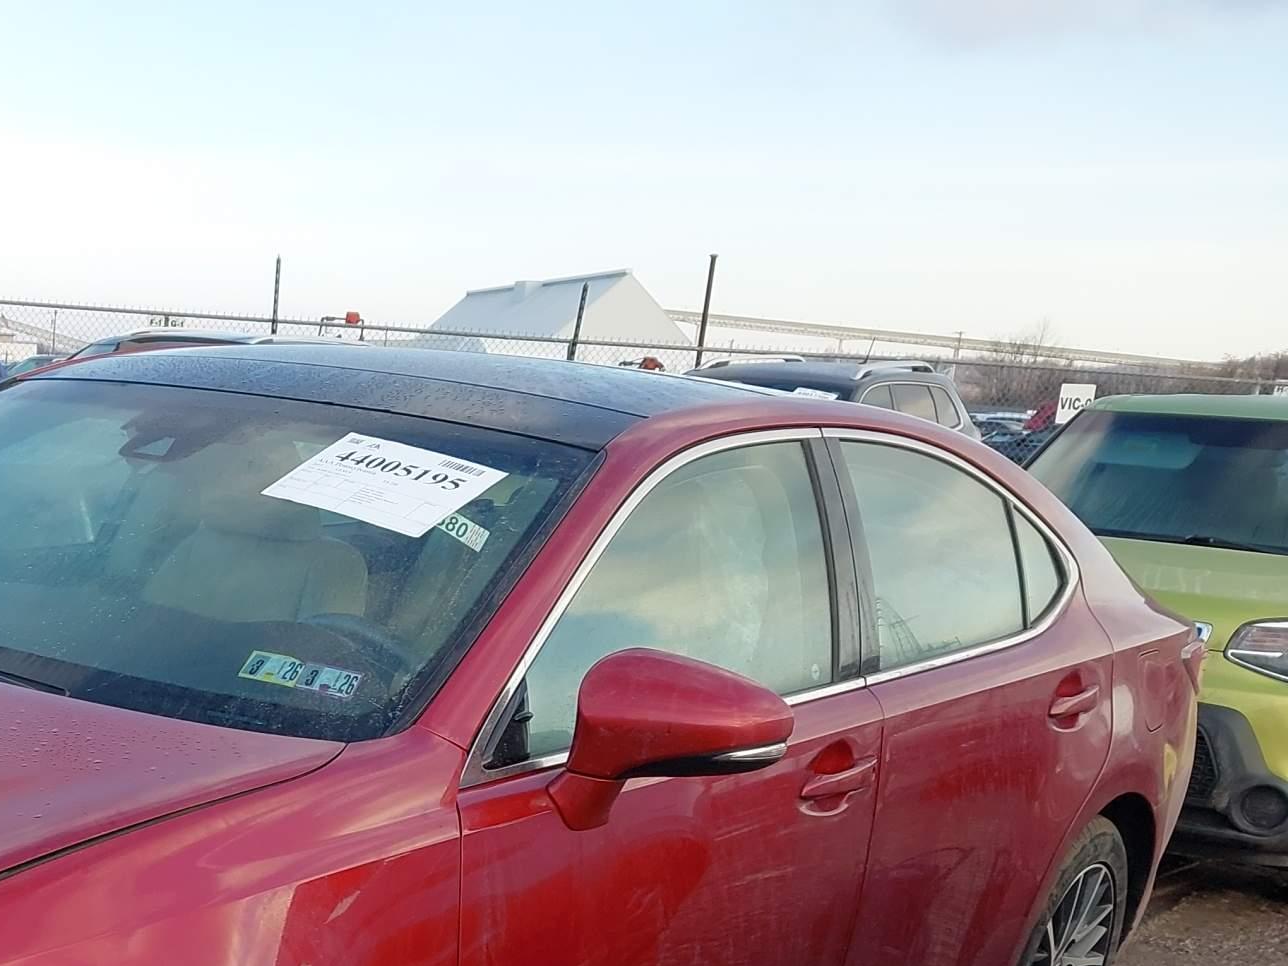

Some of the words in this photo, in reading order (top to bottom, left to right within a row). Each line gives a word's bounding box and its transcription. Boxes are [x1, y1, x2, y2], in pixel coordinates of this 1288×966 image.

[335, 450, 468, 491] 44005195
[249, 659, 264, 676] 3
[282, 661, 303, 682] 26
[304, 669, 319, 687] 3
[338, 674, 359, 696] 26
